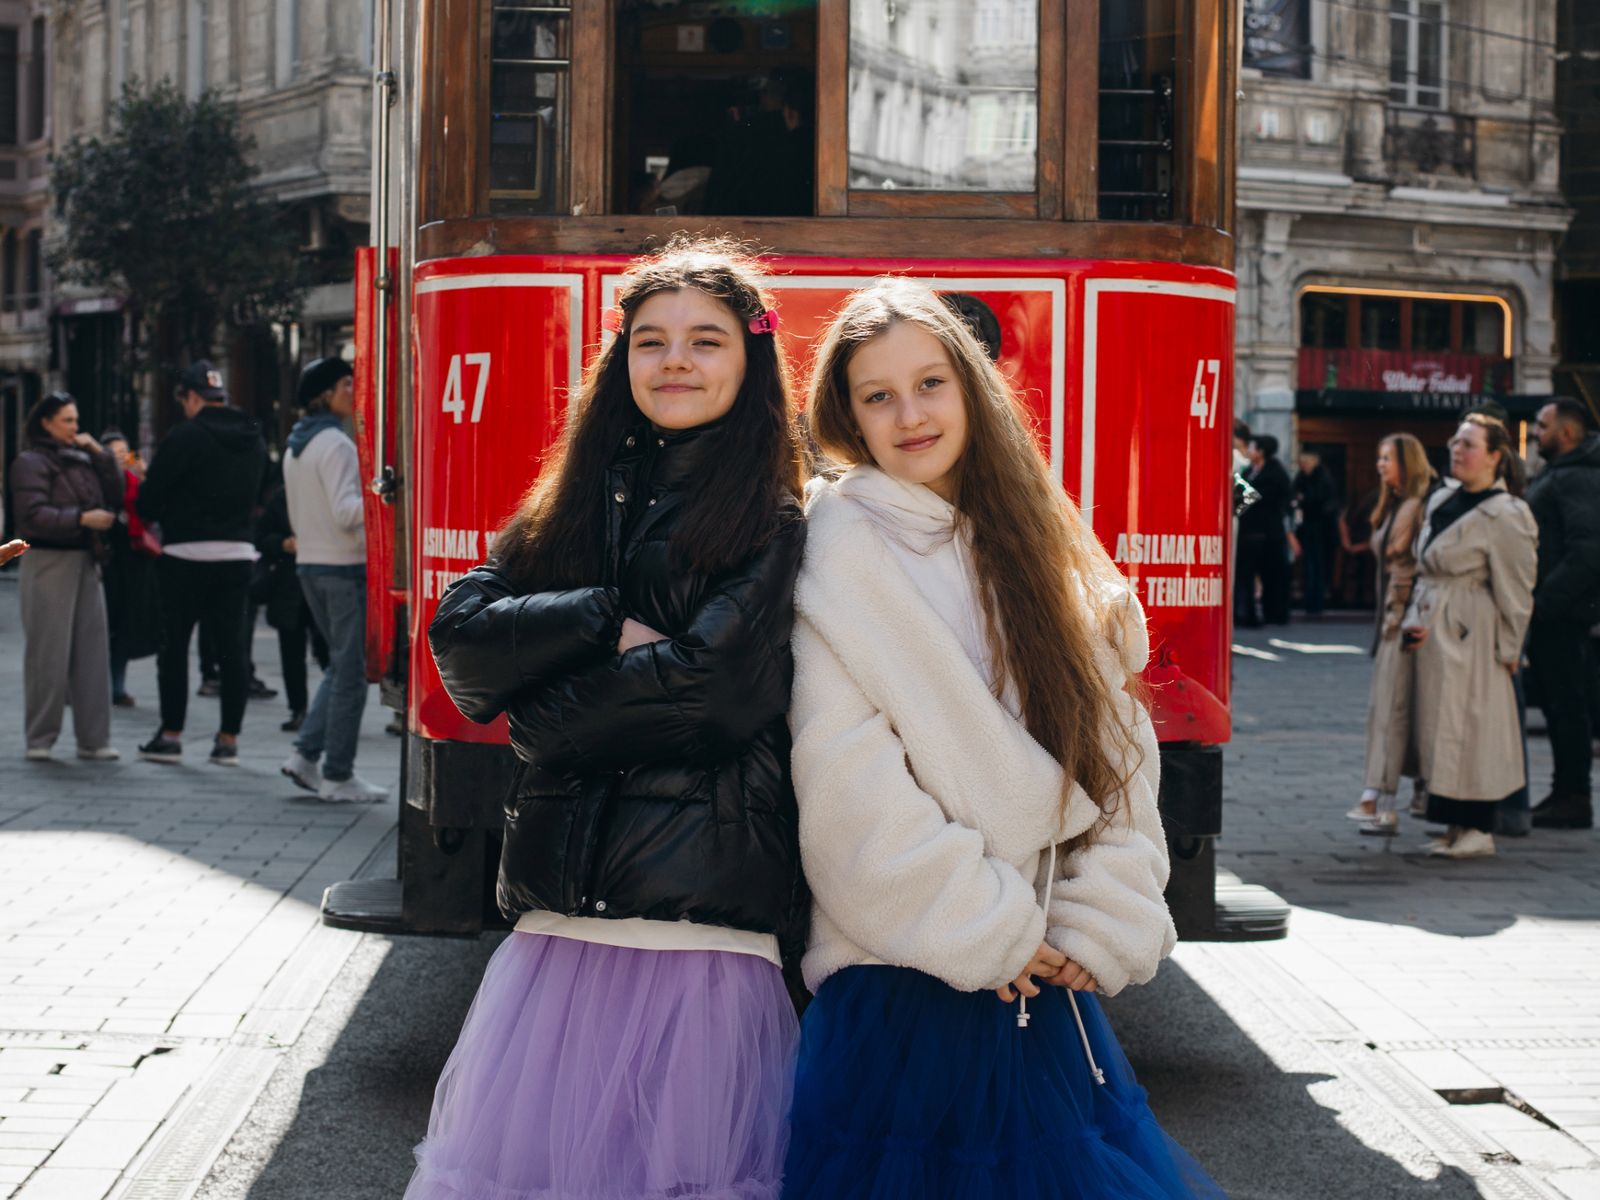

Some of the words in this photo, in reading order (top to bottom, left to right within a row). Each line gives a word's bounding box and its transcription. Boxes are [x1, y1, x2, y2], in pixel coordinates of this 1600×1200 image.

[442, 352, 491, 424] 47
[1190, 359, 1221, 429] 47
[1115, 533, 1195, 565] ASILMAK
